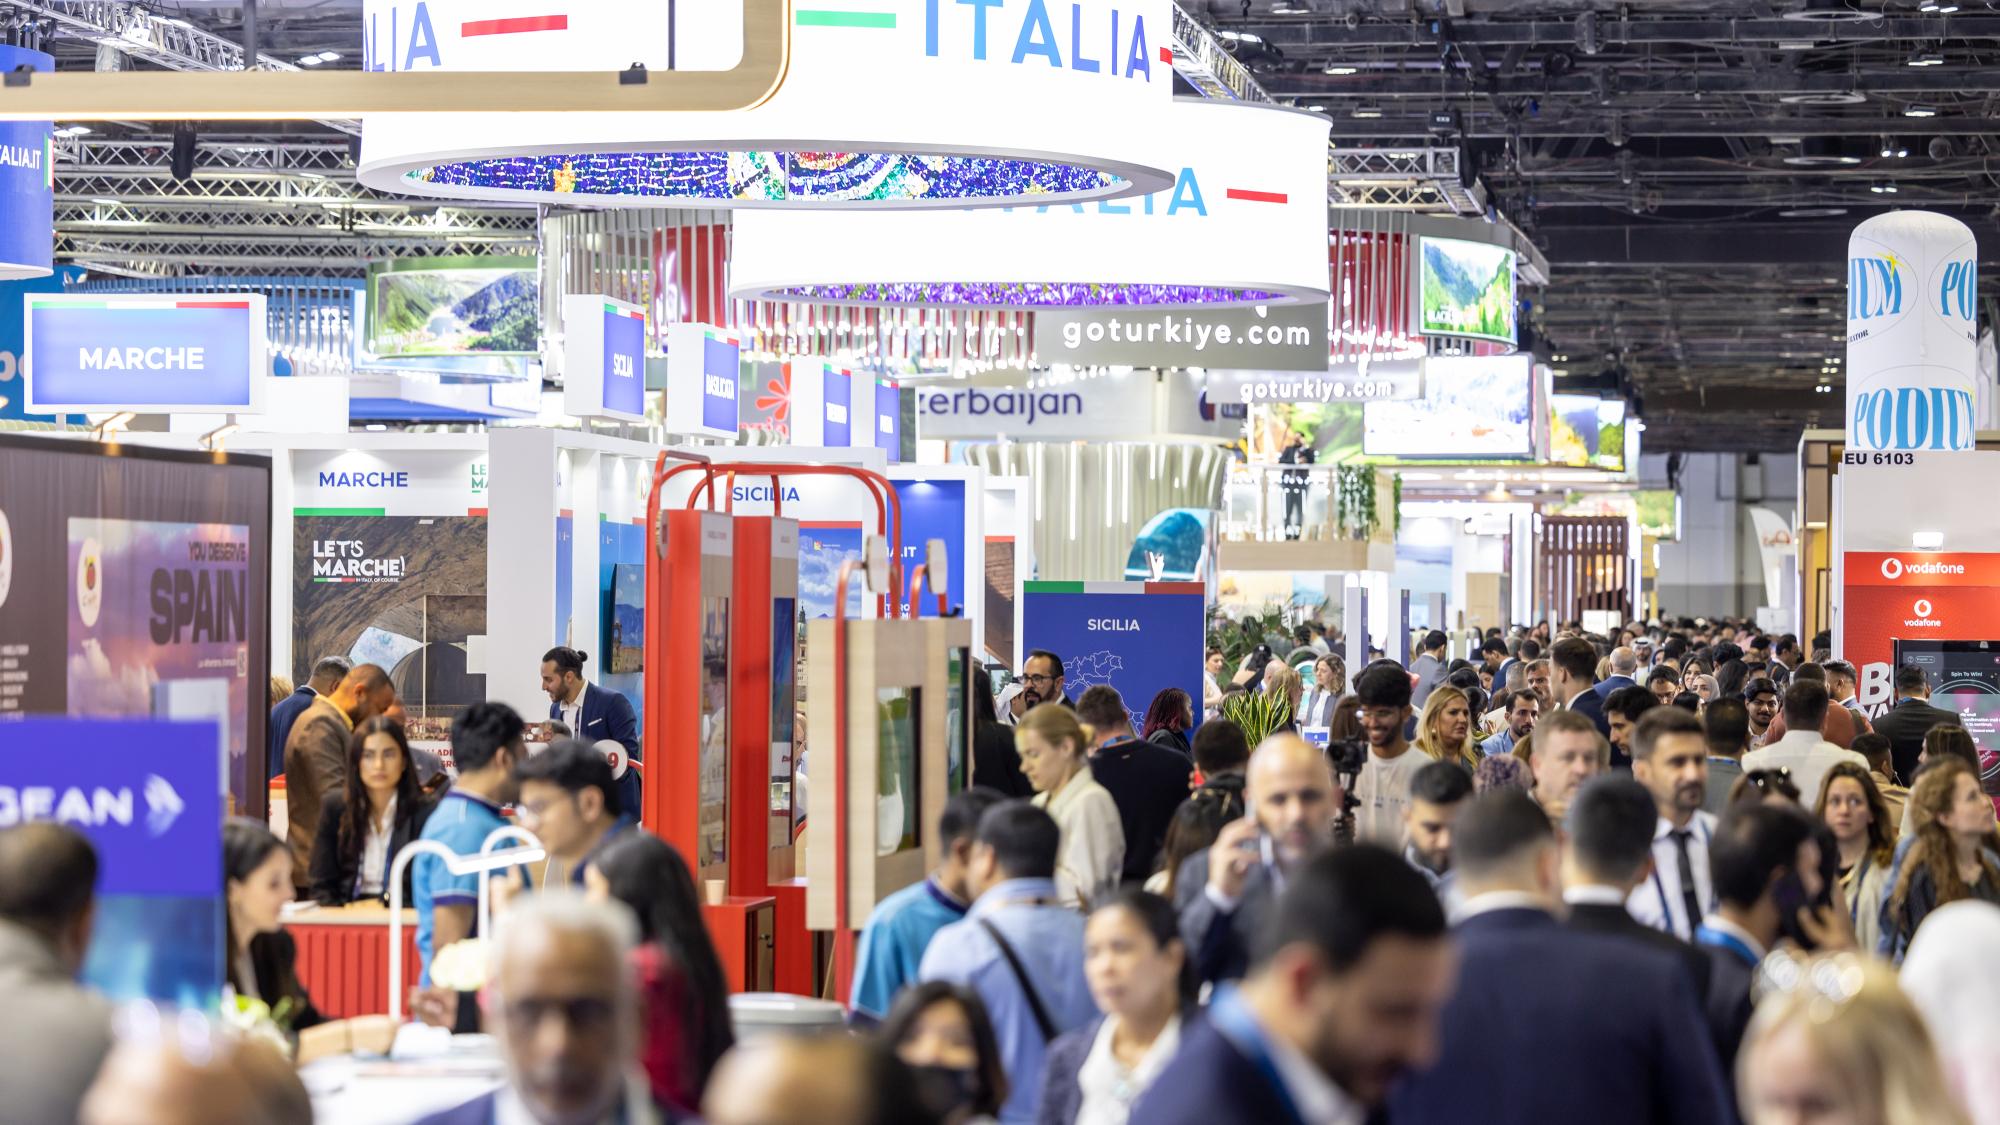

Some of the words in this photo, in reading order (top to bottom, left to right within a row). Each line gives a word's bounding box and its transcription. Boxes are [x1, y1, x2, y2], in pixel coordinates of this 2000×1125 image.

[925, 0, 1150, 83] ITALIA
[1940, 258, 1977, 321] PO
[1062, 315, 1310, 350] goturkiye.com
[79, 346, 205, 371] MARCHE
[1240, 377, 1392, 403] goturkiye.com
[1844, 453, 1868, 465] EU
[1873, 453, 1914, 465] 6103
[319, 471, 409, 487] MARCHE
[188, 541, 207, 562] YOU
[208, 542, 246, 563] DESERVE
[313, 540, 364, 558] LET'S
[1905, 562, 1965, 574] vodafone
[150, 568, 247, 646] SPAIN
[1087, 618, 1141, 631] SICILIA
[1904, 619, 1942, 627] vodafone
